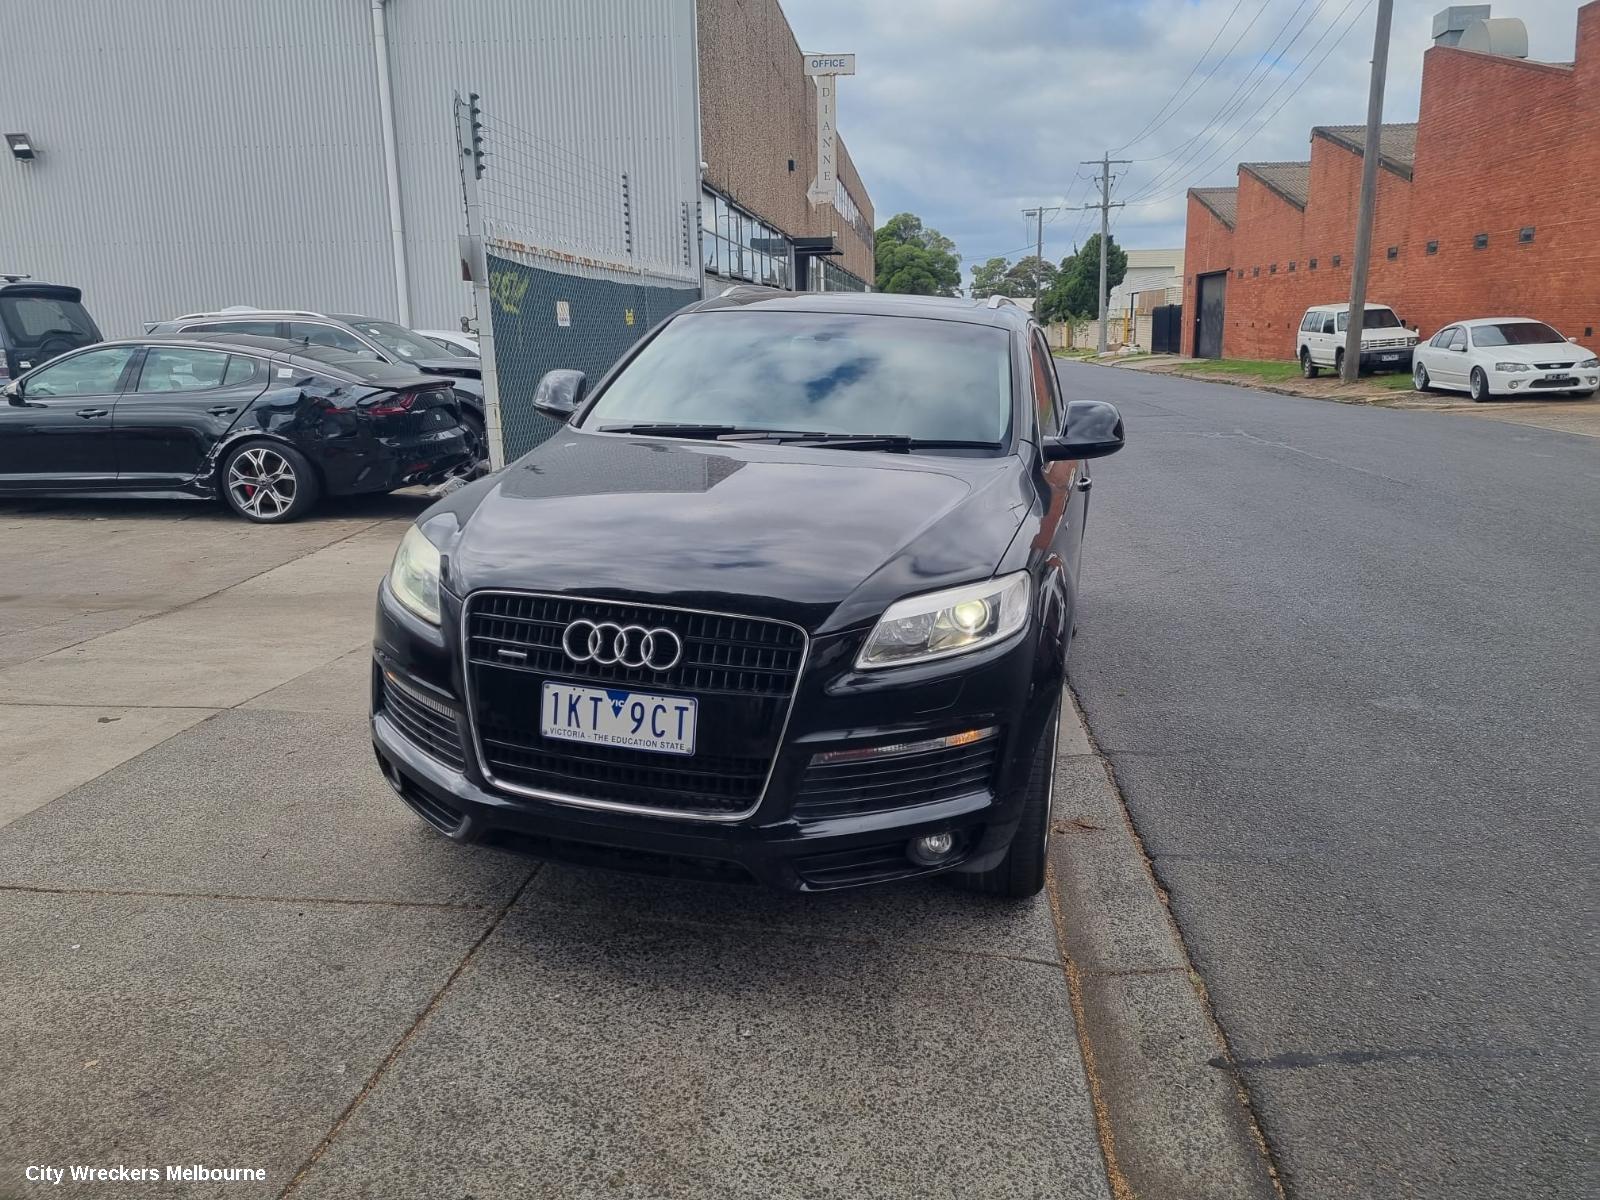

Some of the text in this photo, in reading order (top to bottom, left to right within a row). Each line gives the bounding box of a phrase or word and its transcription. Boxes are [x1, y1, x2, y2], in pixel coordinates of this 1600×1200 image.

[811, 58, 845, 68] OFFICE
[822, 87, 831, 181] DIANNE
[610, 699, 625, 708] VIC
[552, 692, 689, 740] 1KT 9CT
[549, 727, 585, 739] VICTORIA
[593, 733, 609, 742] THE
[611, 735, 658, 748] EDUCATION
[660, 741, 685, 751] STATE
